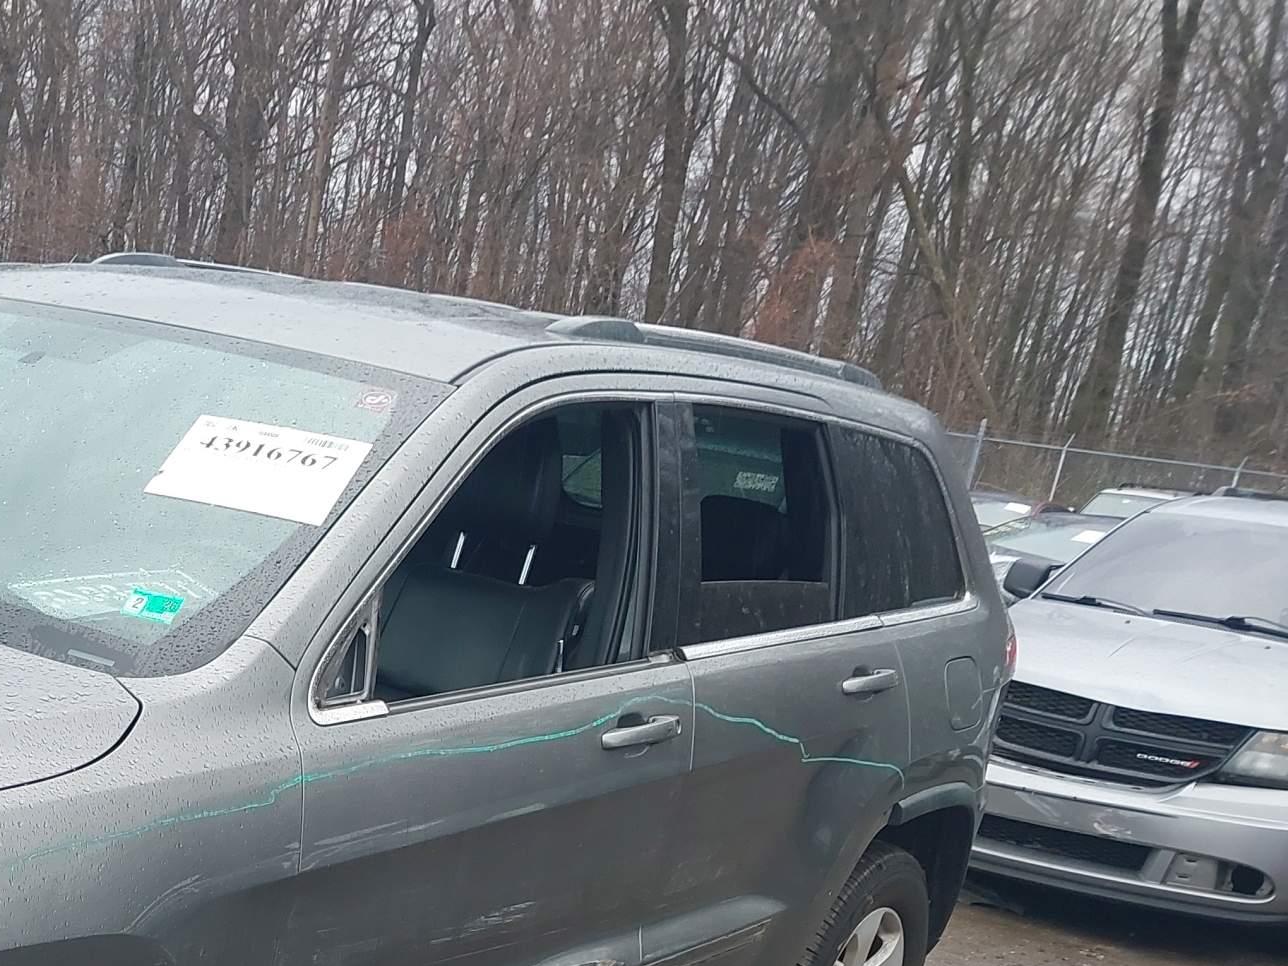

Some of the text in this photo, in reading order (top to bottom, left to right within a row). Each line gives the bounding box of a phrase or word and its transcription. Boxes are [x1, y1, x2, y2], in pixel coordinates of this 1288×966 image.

[199, 434, 339, 470] 43916767
[131, 596, 146, 610] 2
[1135, 752, 1191, 768] DODGE
